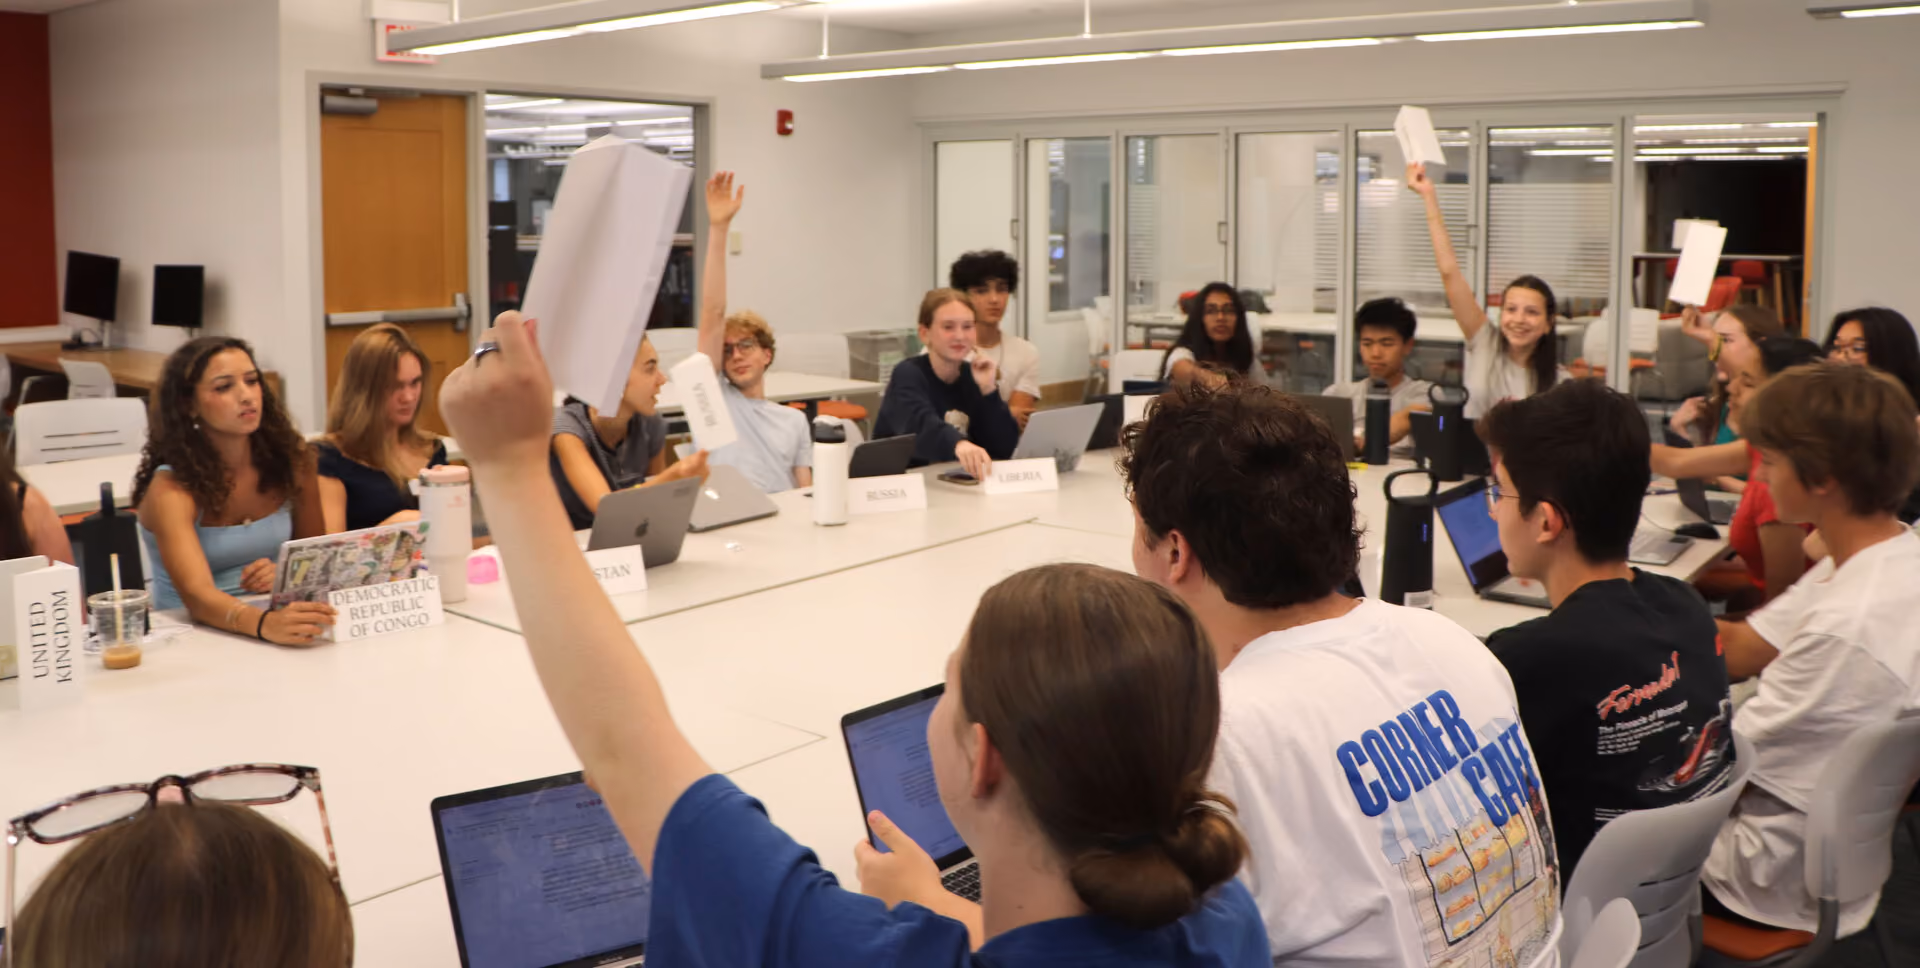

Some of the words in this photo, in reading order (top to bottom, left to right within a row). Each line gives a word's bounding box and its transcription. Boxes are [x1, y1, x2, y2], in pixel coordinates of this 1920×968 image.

[997, 470, 1043, 484] LIBERIA
[866, 488, 907, 502] RUSSIA
[333, 577, 435, 606] DEMOCRATIC
[350, 596, 424, 620] REPUBLIC
[51, 590, 72, 683] KINGDOM
[349, 623, 371, 638] OF
[374, 612, 430, 634] CONGO
[29, 602, 49, 678] UNITED
[1598, 726, 1614, 735] The
[1336, 689, 1479, 817] CORNER
